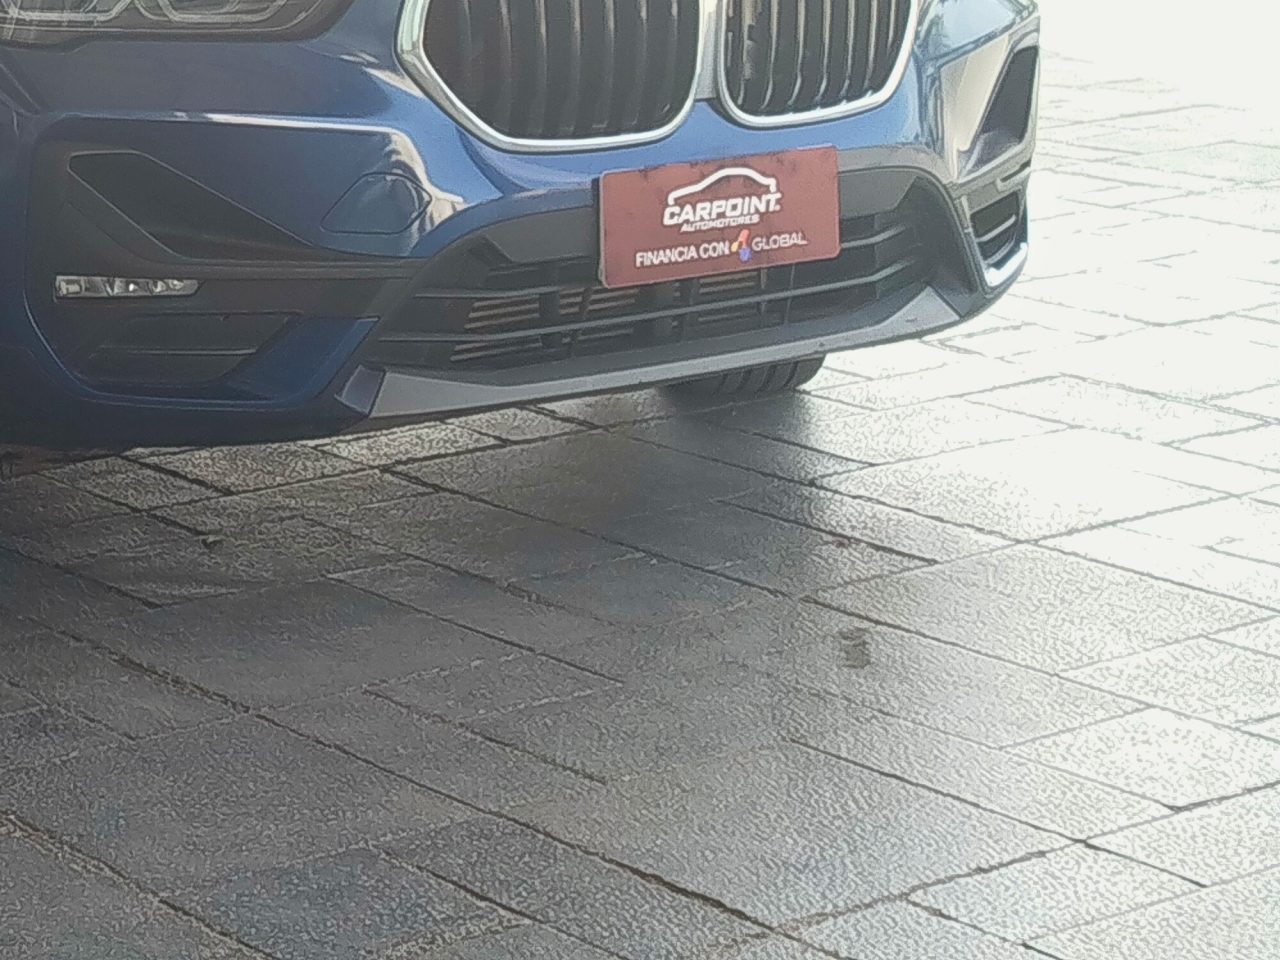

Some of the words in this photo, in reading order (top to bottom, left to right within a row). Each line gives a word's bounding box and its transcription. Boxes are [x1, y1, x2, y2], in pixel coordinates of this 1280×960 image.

[680, 214, 761, 233] AUTOMOTORES
[635, 245, 699, 268] FINANCIA
[699, 241, 731, 259] CON
[751, 232, 808, 252] GLOBAL
